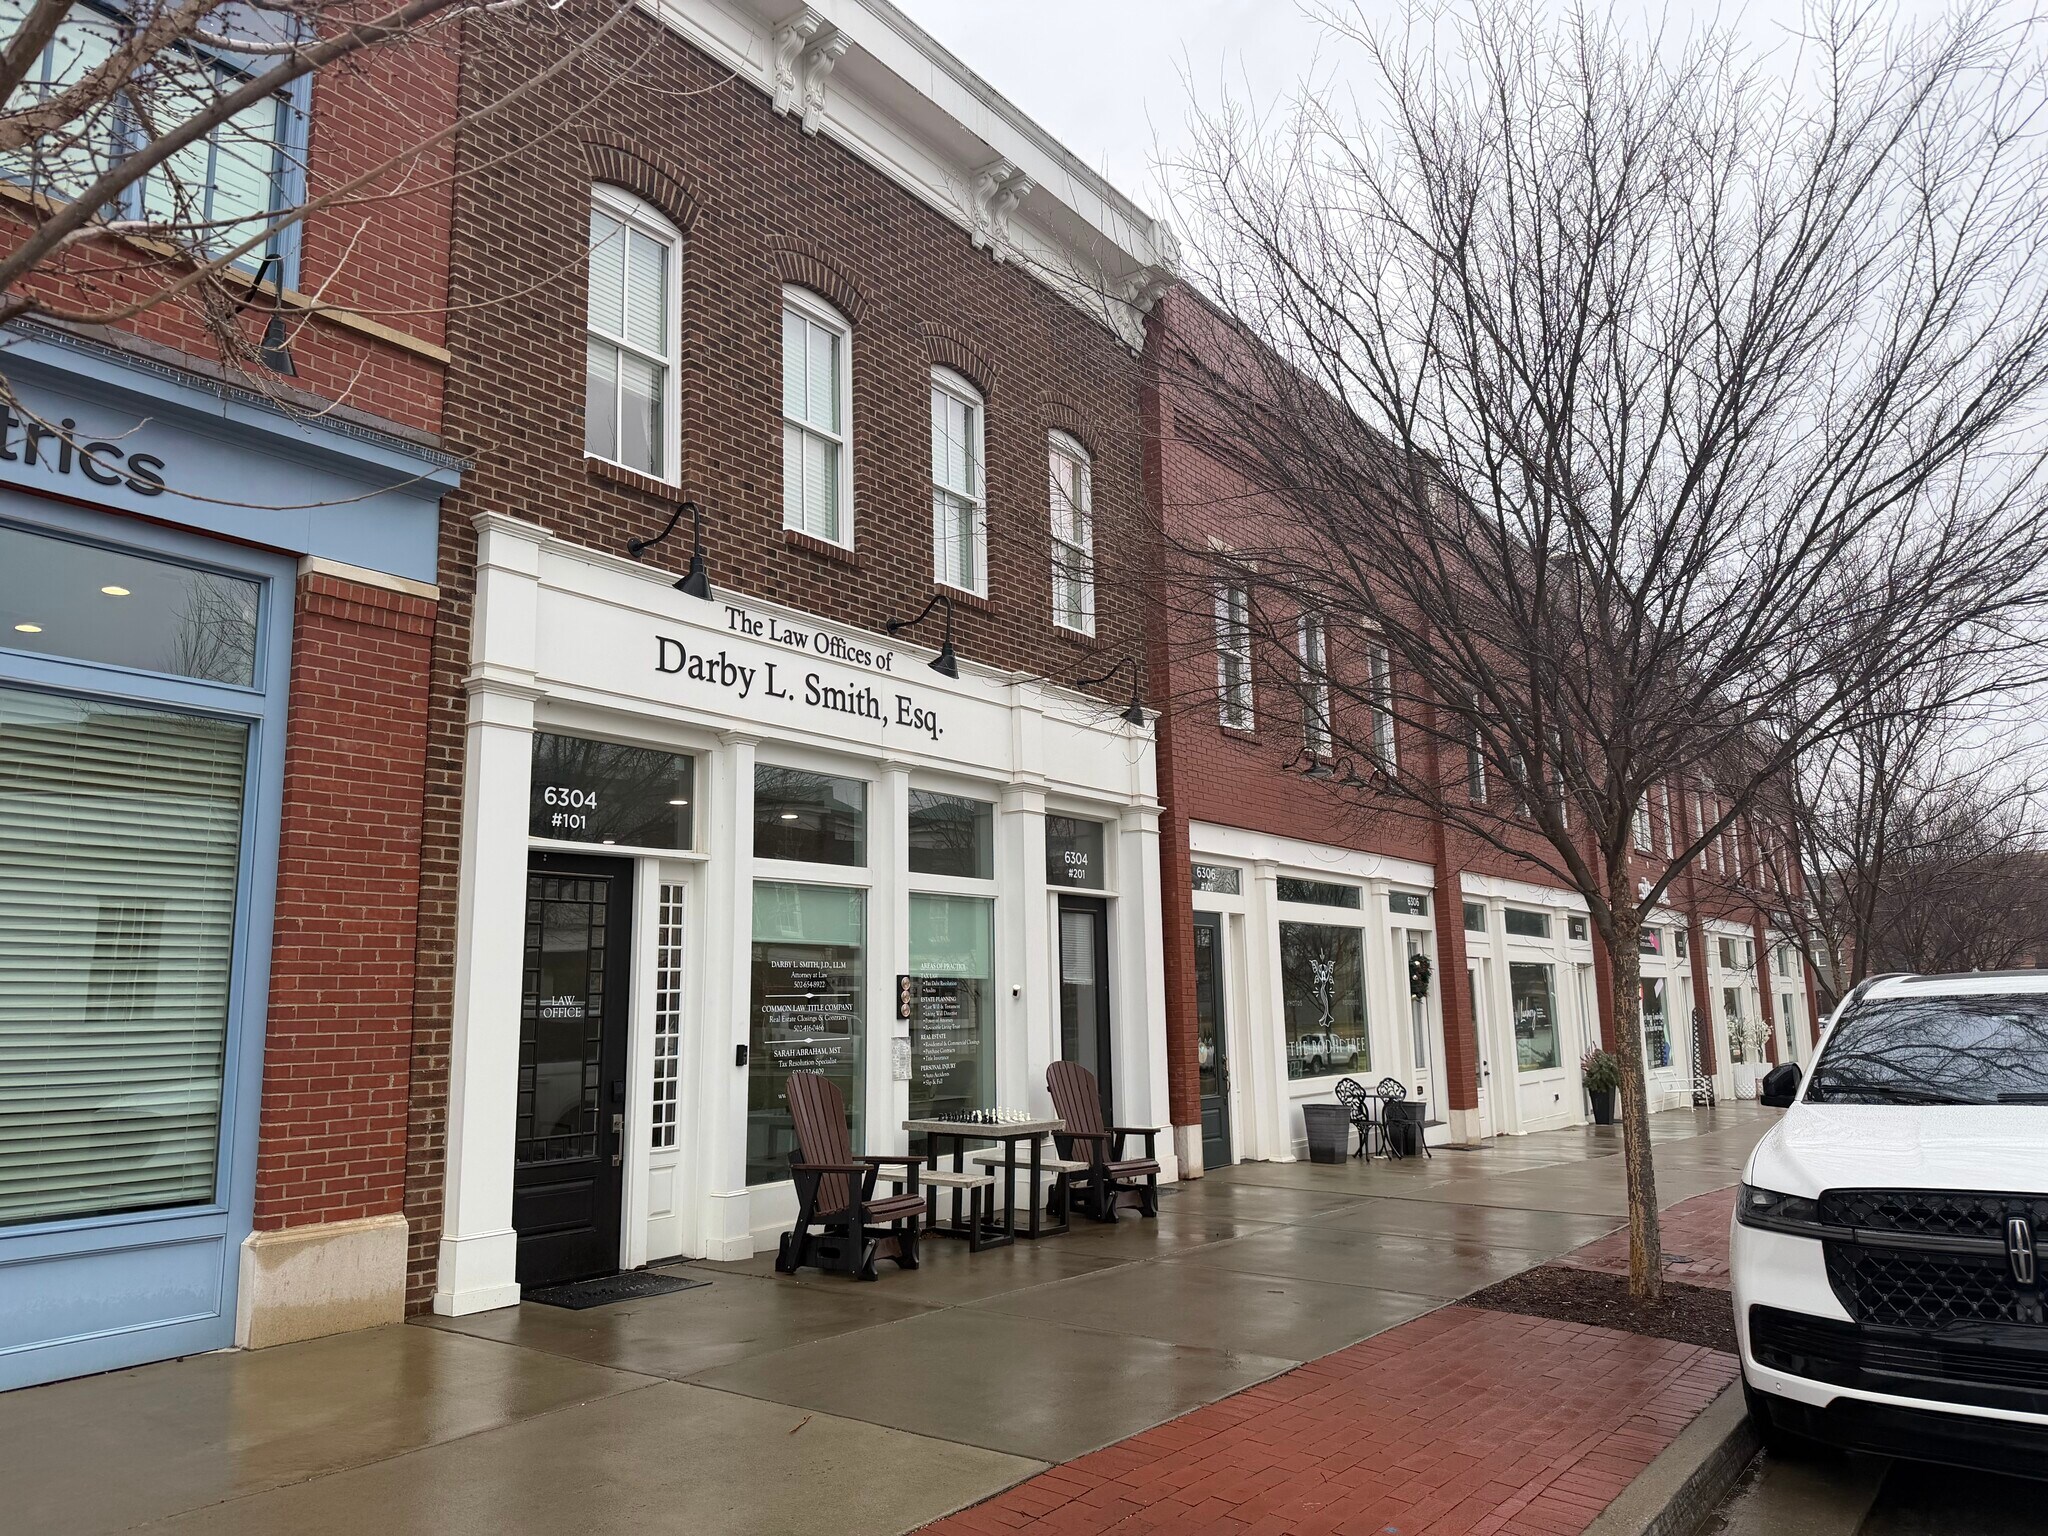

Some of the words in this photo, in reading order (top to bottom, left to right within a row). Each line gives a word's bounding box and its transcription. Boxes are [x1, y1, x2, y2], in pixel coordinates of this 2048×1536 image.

[725, 606, 764, 637] The
[768, 618, 809, 650] Law
[813, 632, 872, 667] Offices
[875, 651, 894, 672] of
[655, 635, 757, 699] Darby
[764, 662, 795, 701] L.
[804, 673, 889, 728] Smith,
[895, 694, 944, 741] Esq.
[543, 786, 598, 810] 6304
[551, 812, 587, 830] #101
[1064, 850, 1089, 866] 6304
[1068, 868, 1086, 879] #201
[1196, 866, 1216, 880] 6306
[771, 960, 792, 969] DARBY
[791, 971, 811, 979] Attorney
[552, 995, 575, 1006] LAW
[543, 1007, 582, 1018] OFFICE
[761, 1004, 792, 1013] COMMON
[793, 1004, 806, 1012] LAW
[807, 1004, 824, 1012] TITLE
[824, 1003, 853, 1012] COMPANY
[769, 1015, 781, 1023] Real
[782, 1015, 797, 1023] Estate
[797, 1013, 818, 1022] Closings
[773, 1049, 795, 1058] SARAH
[795, 1048, 828, 1057] ABRAHAM,
[828, 1046, 842, 1055] MST
[1288, 1040, 1309, 1057] THE
[1345, 1036, 1366, 1052] TREE
[778, 1060, 788, 1068] Tax
[788, 1059, 815, 1067] Resolution
[815, 1058, 837, 1066] Specialist
[920, 1064, 942, 1072] PERSONAL
[942, 1062, 957, 1071] INJURY
